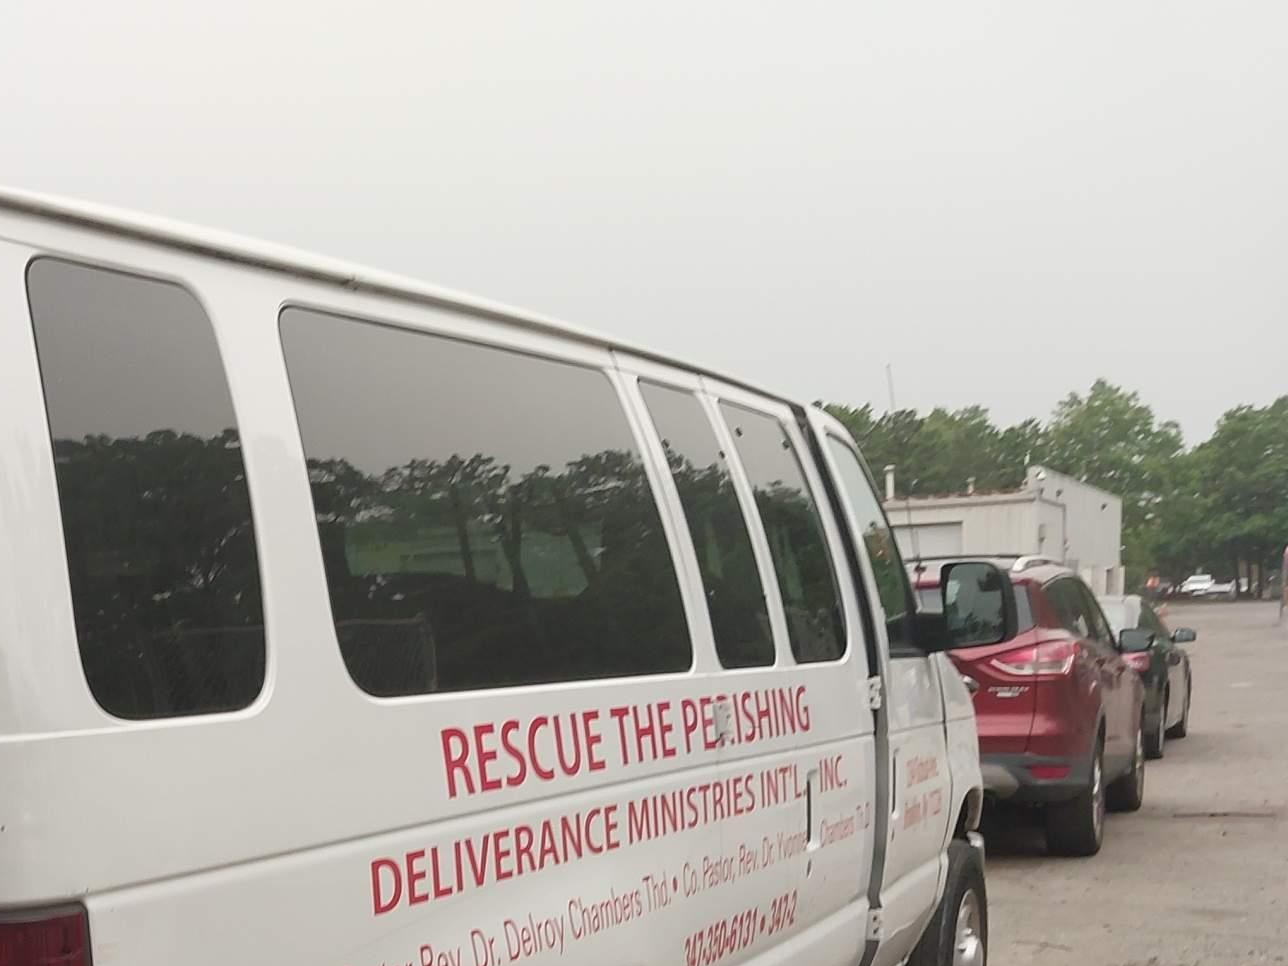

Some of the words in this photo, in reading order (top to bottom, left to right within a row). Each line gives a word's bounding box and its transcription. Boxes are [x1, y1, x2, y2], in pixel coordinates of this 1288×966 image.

[440, 709, 607, 800] RESCUE
[609, 700, 677, 766] THE
[370, 806, 620, 915] DELIVERANCE
[628, 772, 756, 848] MINISTRIES
[818, 754, 849, 793] INC.
[503, 912, 565, 962] Delroy
[568, 887, 643, 940] Chambers
